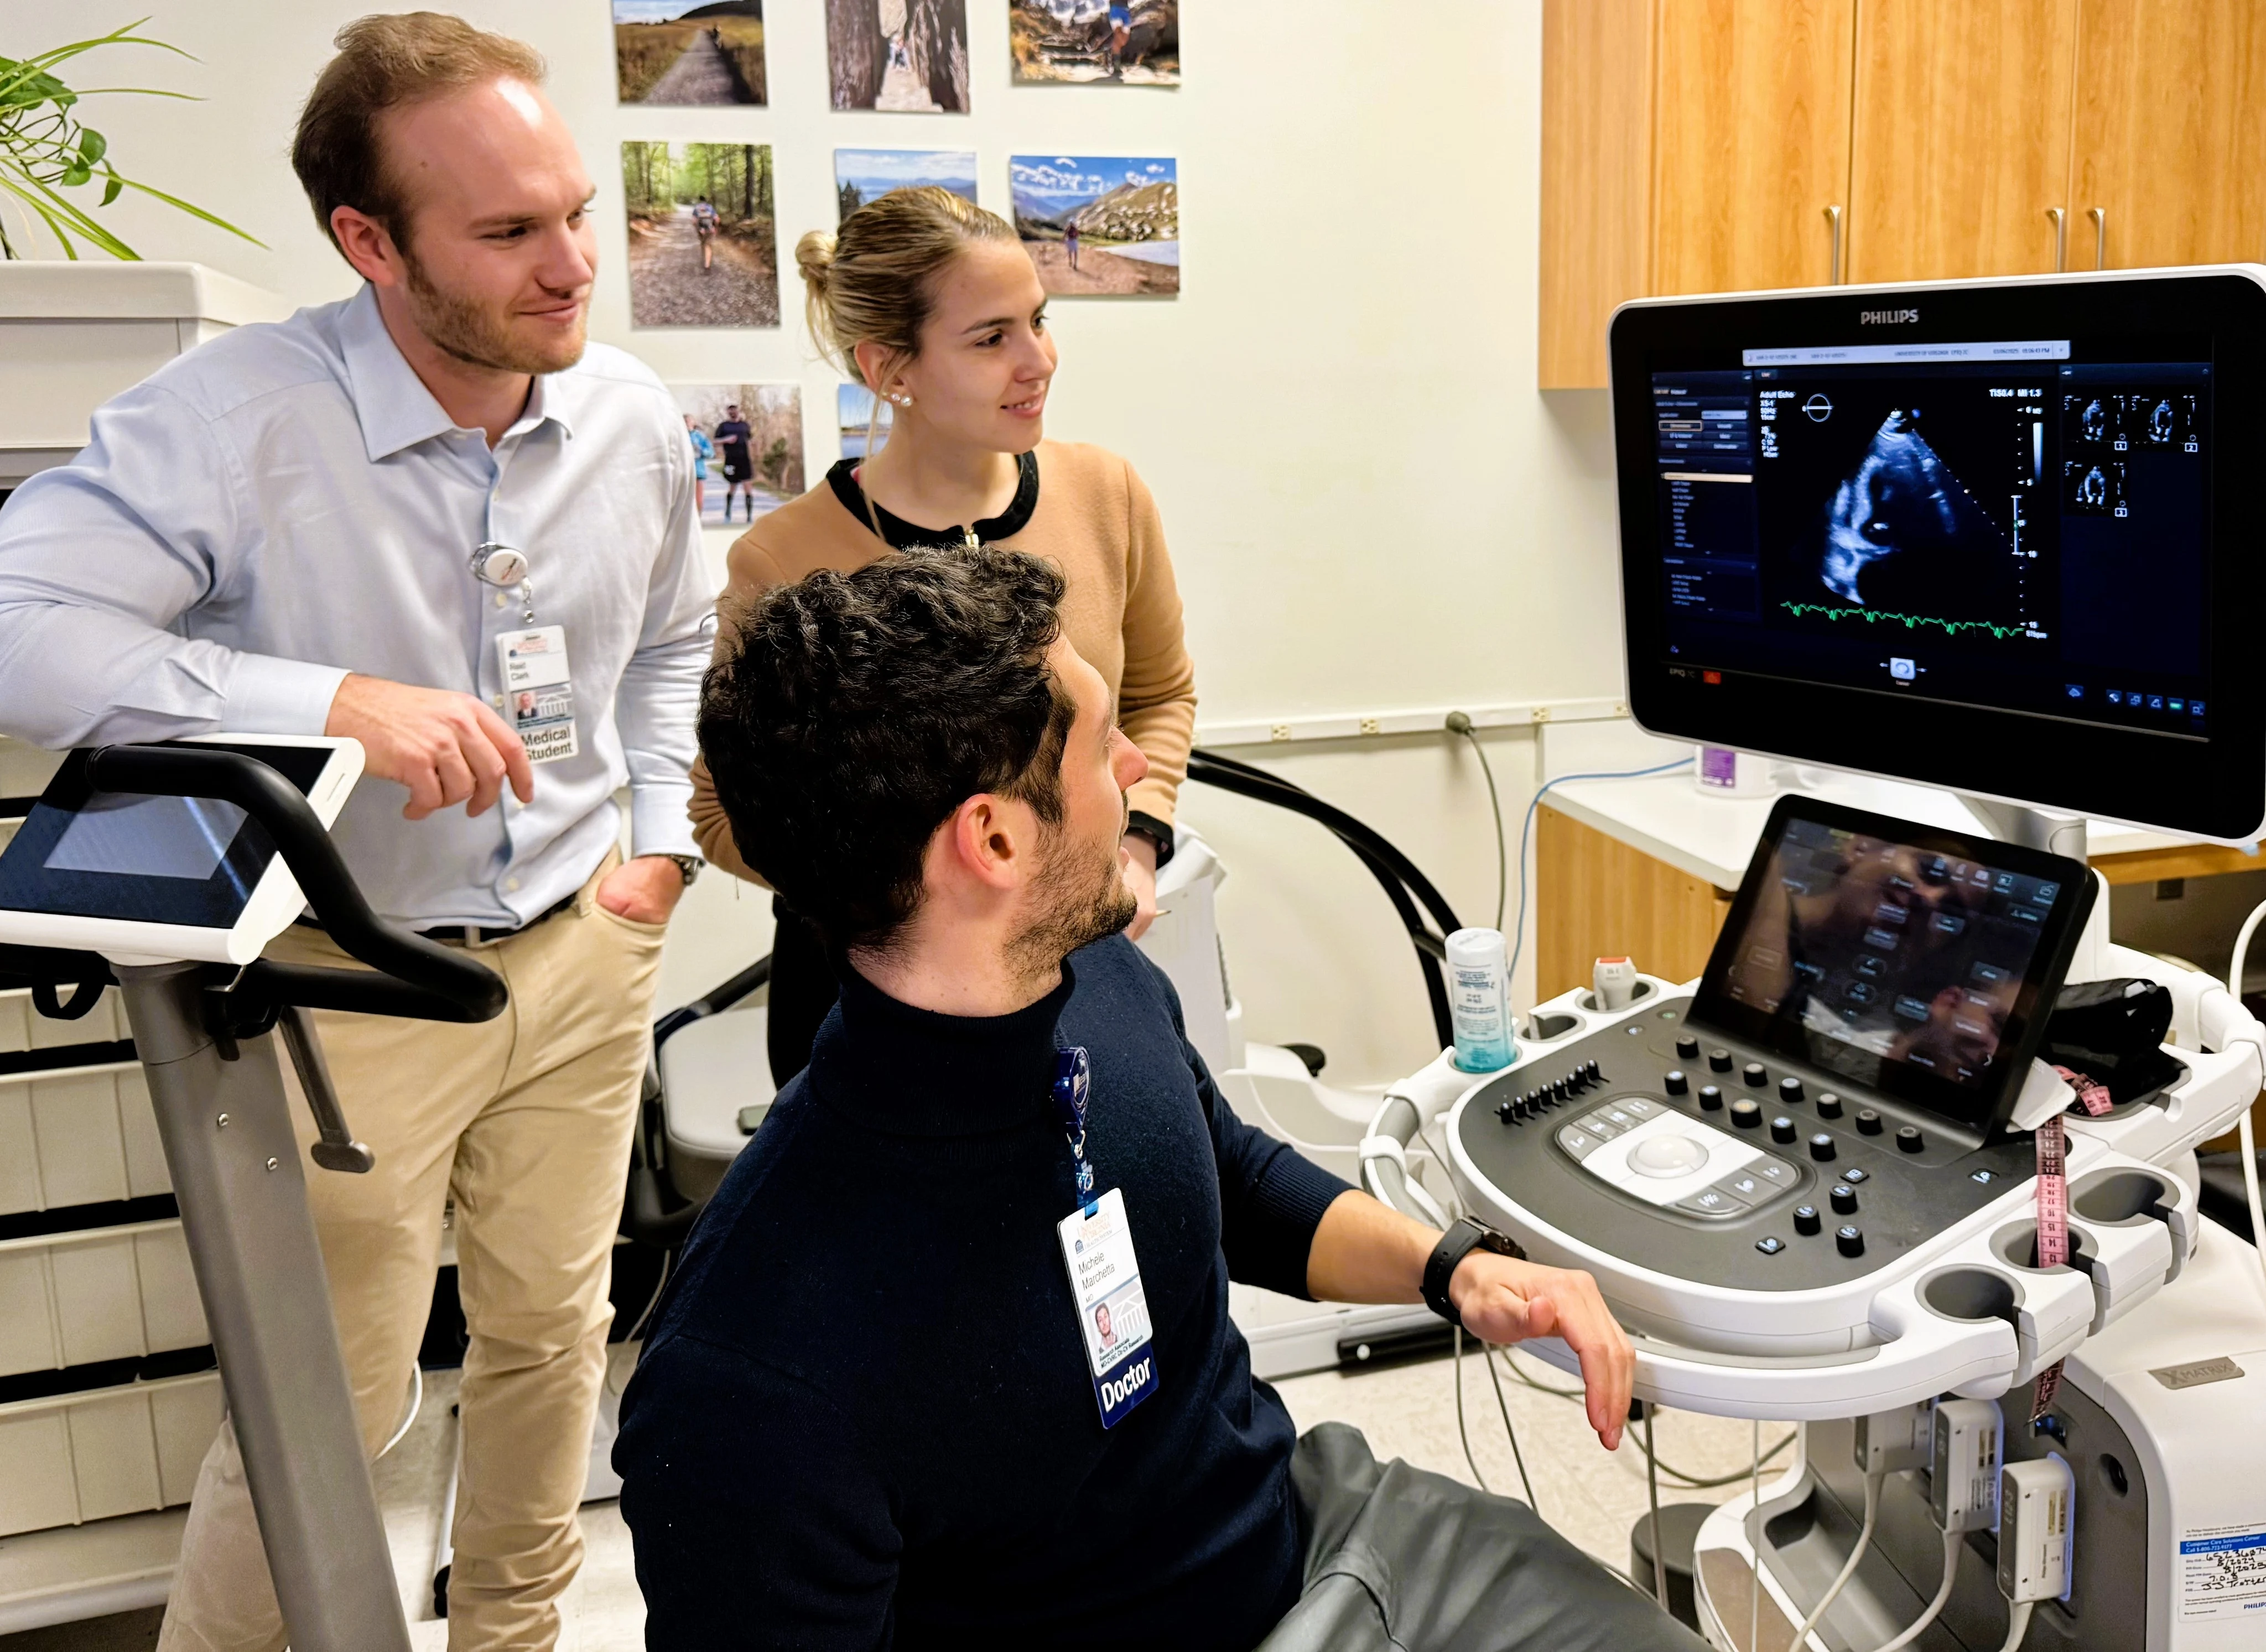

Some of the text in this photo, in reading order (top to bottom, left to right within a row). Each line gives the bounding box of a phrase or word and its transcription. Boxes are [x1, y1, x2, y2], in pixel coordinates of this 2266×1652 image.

[1860, 309, 1919, 325] PHILIPS
[1989, 388, 2043, 397] TIS0.4 MI 1.3
[521, 726, 570, 747] Medical
[526, 742, 573, 760] Student
[2047, 1223, 2055, 1232] 15
[2049, 1238, 2056, 1247] 14
[1078, 1252, 1105, 1275] Michele
[2049, 1253, 2056, 1263] 13
[1082, 1263, 1115, 1291] Marchetta
[1100, 1357, 1151, 1413] Doctor
